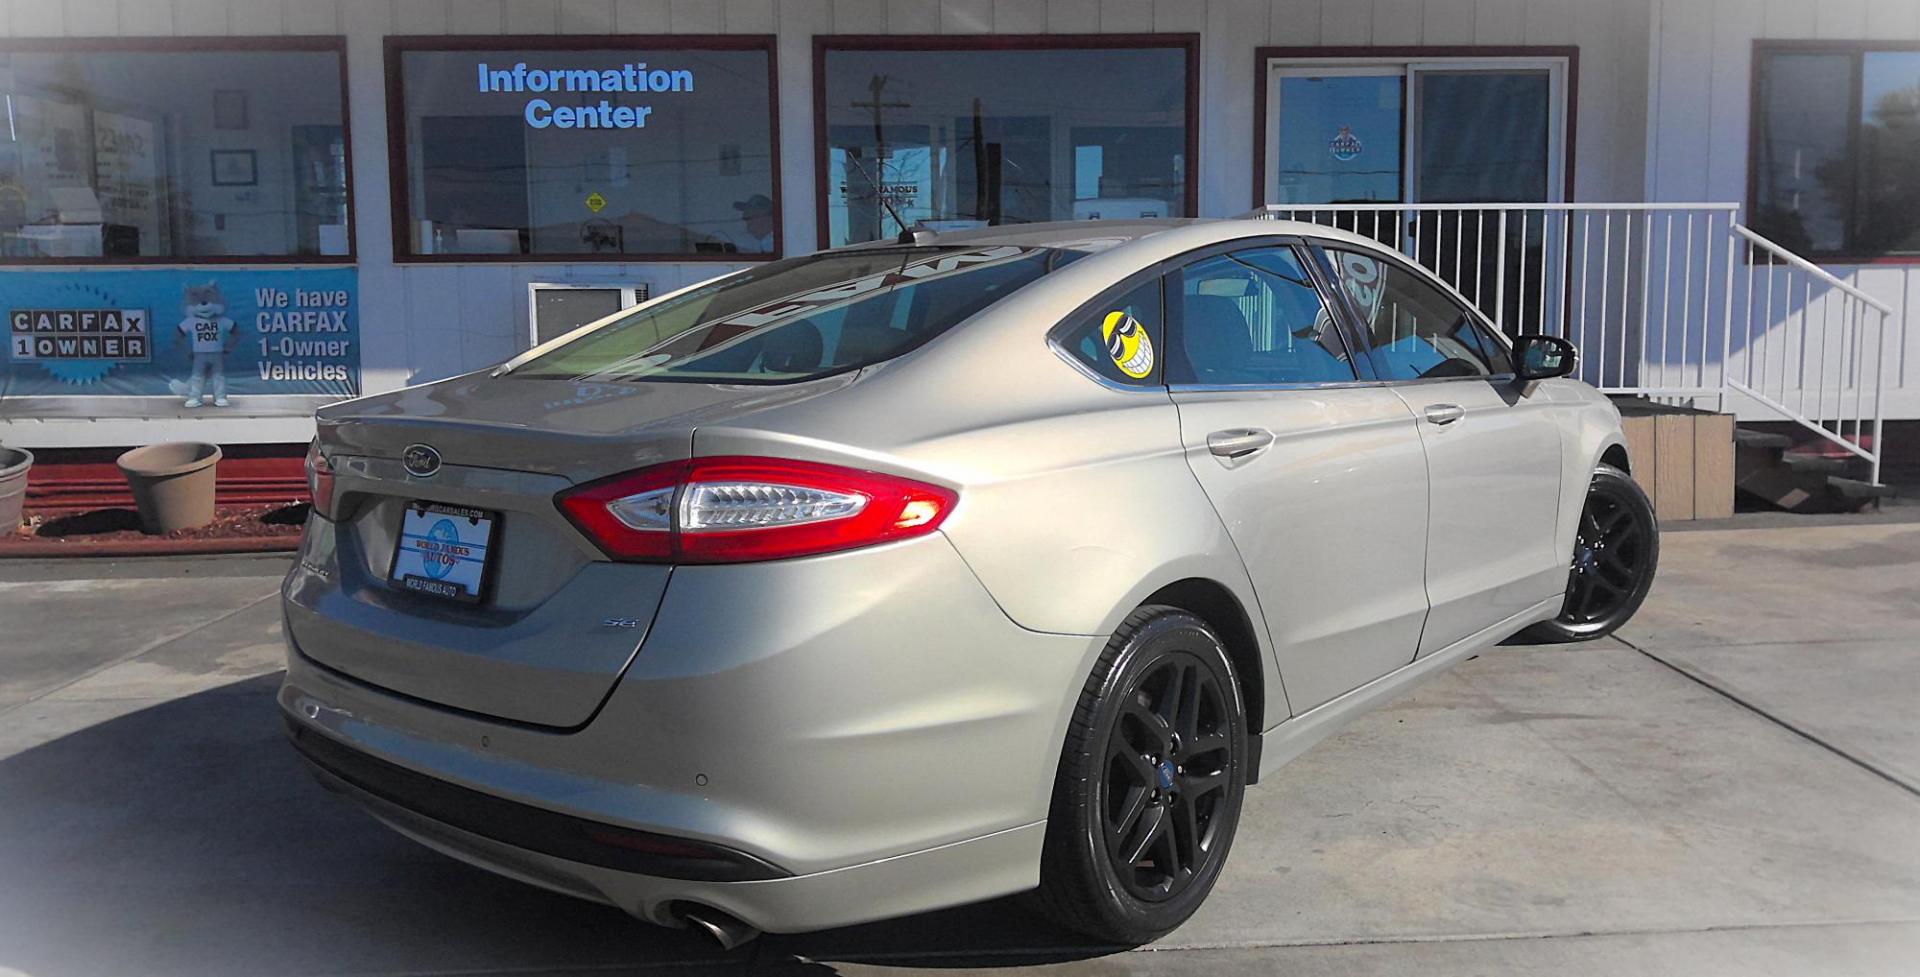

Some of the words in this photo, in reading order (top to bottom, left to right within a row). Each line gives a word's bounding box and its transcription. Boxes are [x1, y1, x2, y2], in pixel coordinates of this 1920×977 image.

[478, 62, 694, 93] Information
[524, 98, 652, 129] Center
[255, 288, 288, 308] We
[296, 288, 348, 307] have
[14, 313, 141, 333] CARFAX
[195, 322, 219, 332] CAR
[256, 311, 348, 333] CARFAX
[18, 339, 30, 355] 1
[38, 340, 142, 355] OWNER
[197, 332, 219, 342] FOX
[258, 336, 349, 357] 1-Owner
[257, 361, 348, 381] Vehicles
